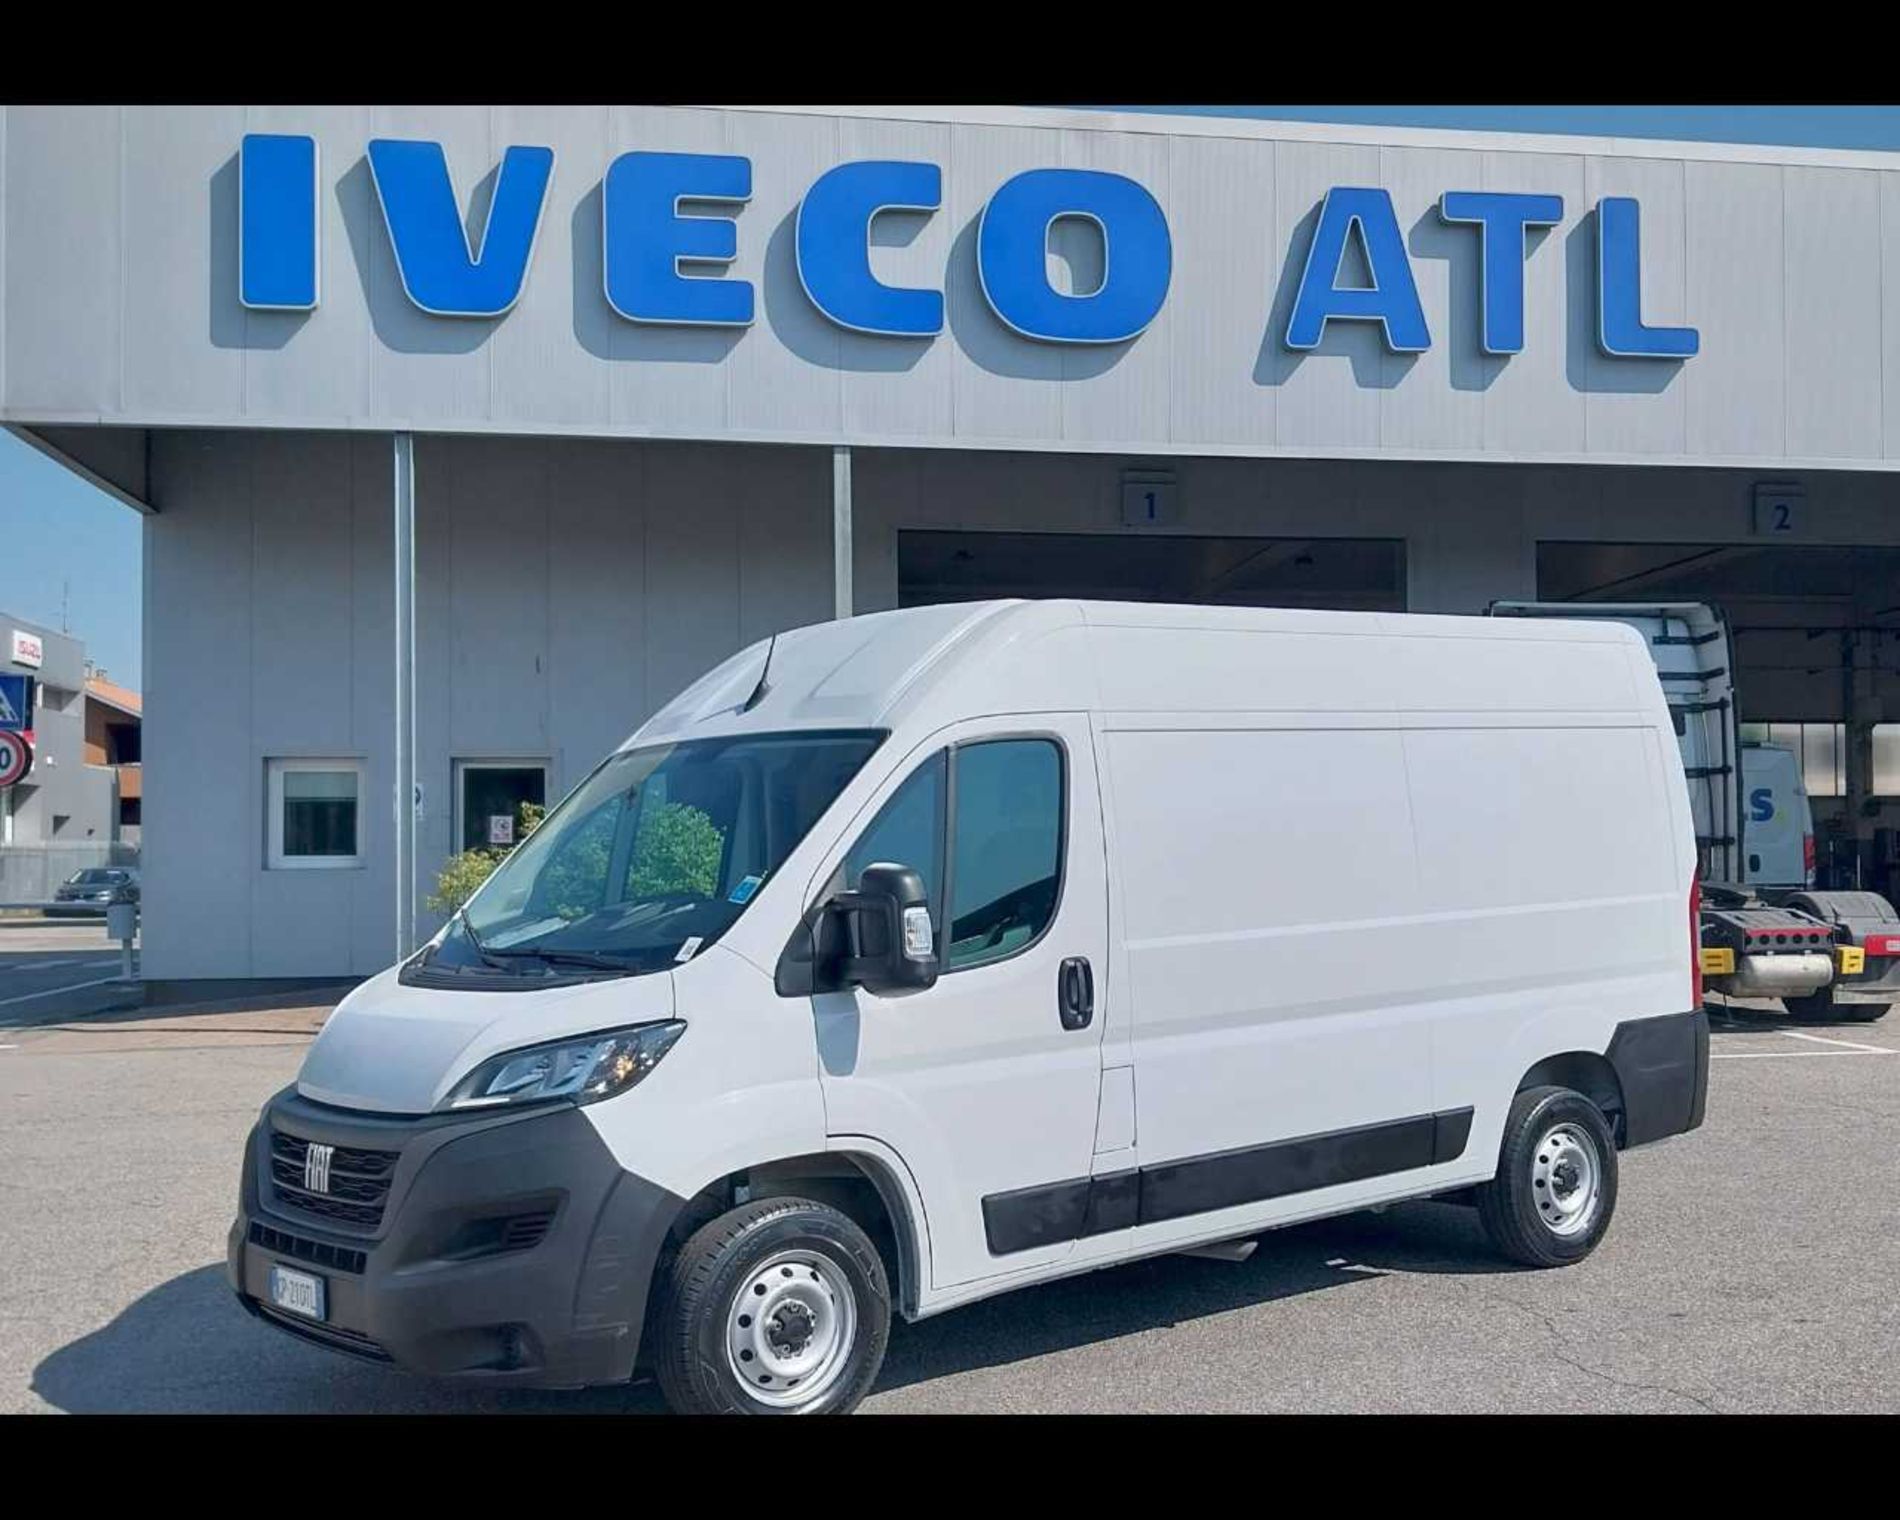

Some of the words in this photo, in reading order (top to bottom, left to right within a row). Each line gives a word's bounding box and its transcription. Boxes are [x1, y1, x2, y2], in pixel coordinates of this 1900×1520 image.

[238, 133, 1173, 344] IVECO
[1286, 187, 1699, 358] ATL
[1143, 492, 1155, 519] 1
[1774, 505, 1791, 531] 2
[304, 1142, 334, 1193] FIAT
